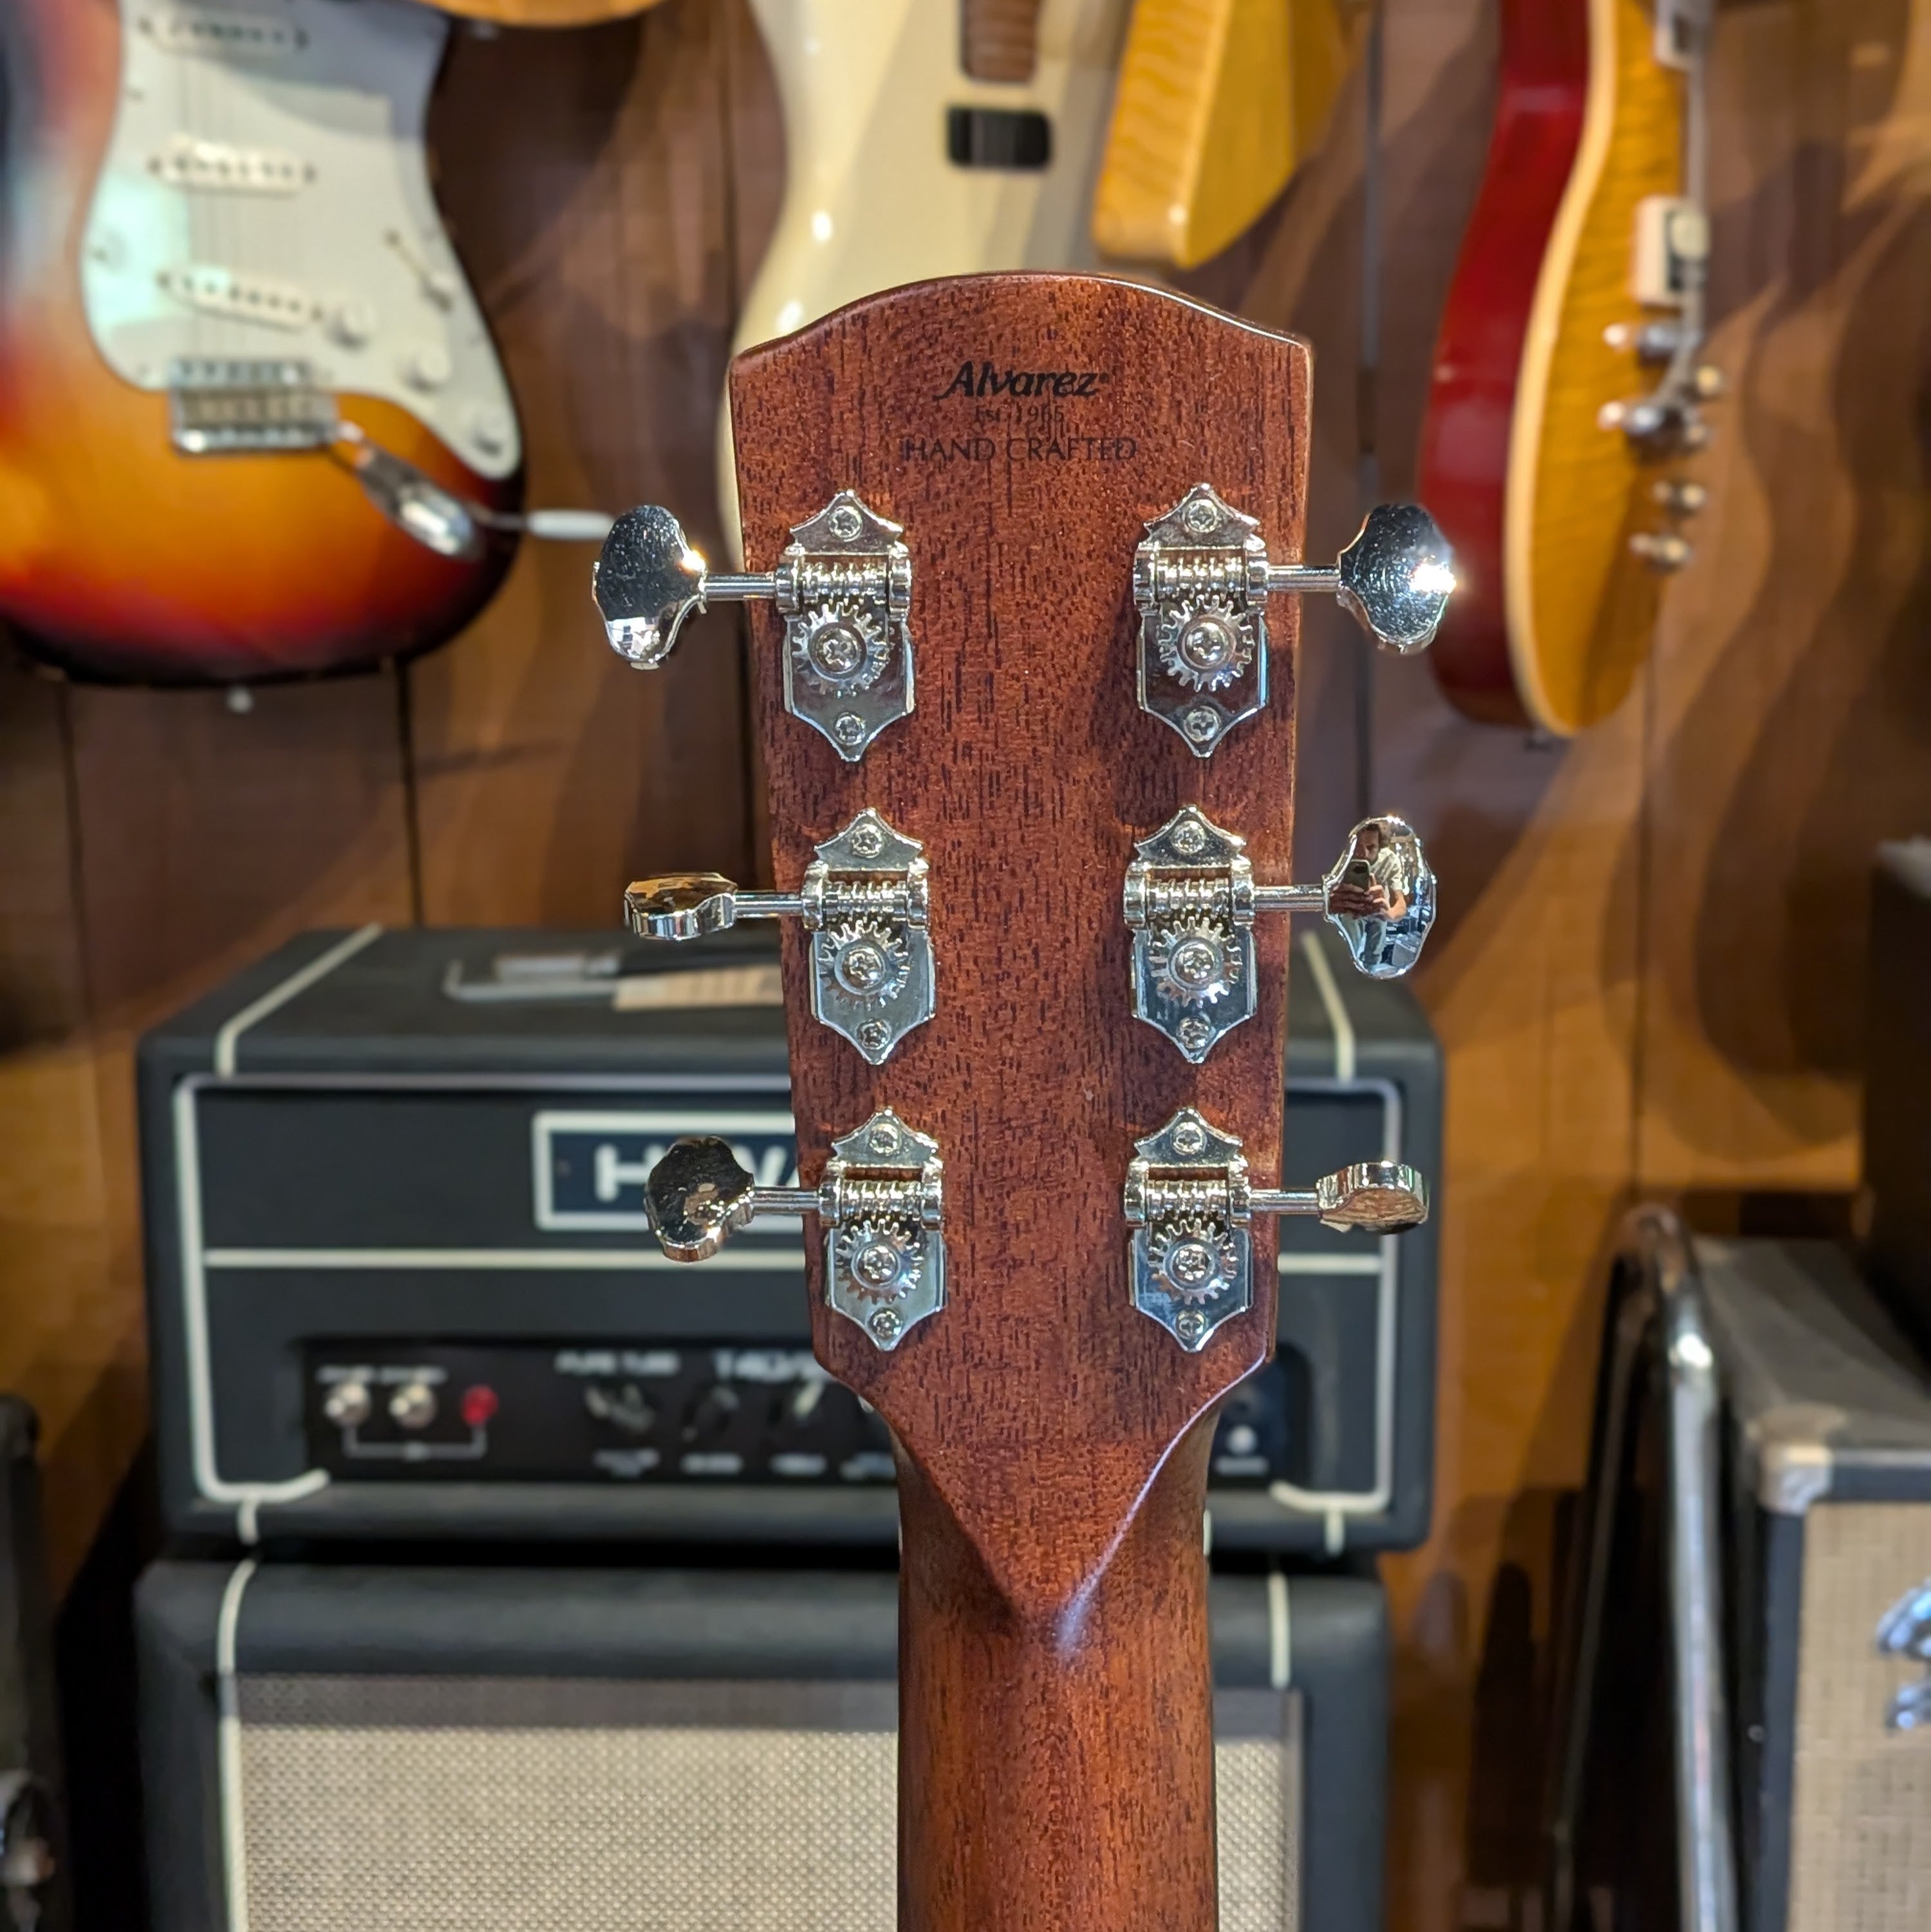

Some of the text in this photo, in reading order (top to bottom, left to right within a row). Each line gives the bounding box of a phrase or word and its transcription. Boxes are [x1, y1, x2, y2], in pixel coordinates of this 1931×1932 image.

[933, 360, 1101, 401] Alvarez
[903, 436, 1136, 462] HAND CRAFTED
